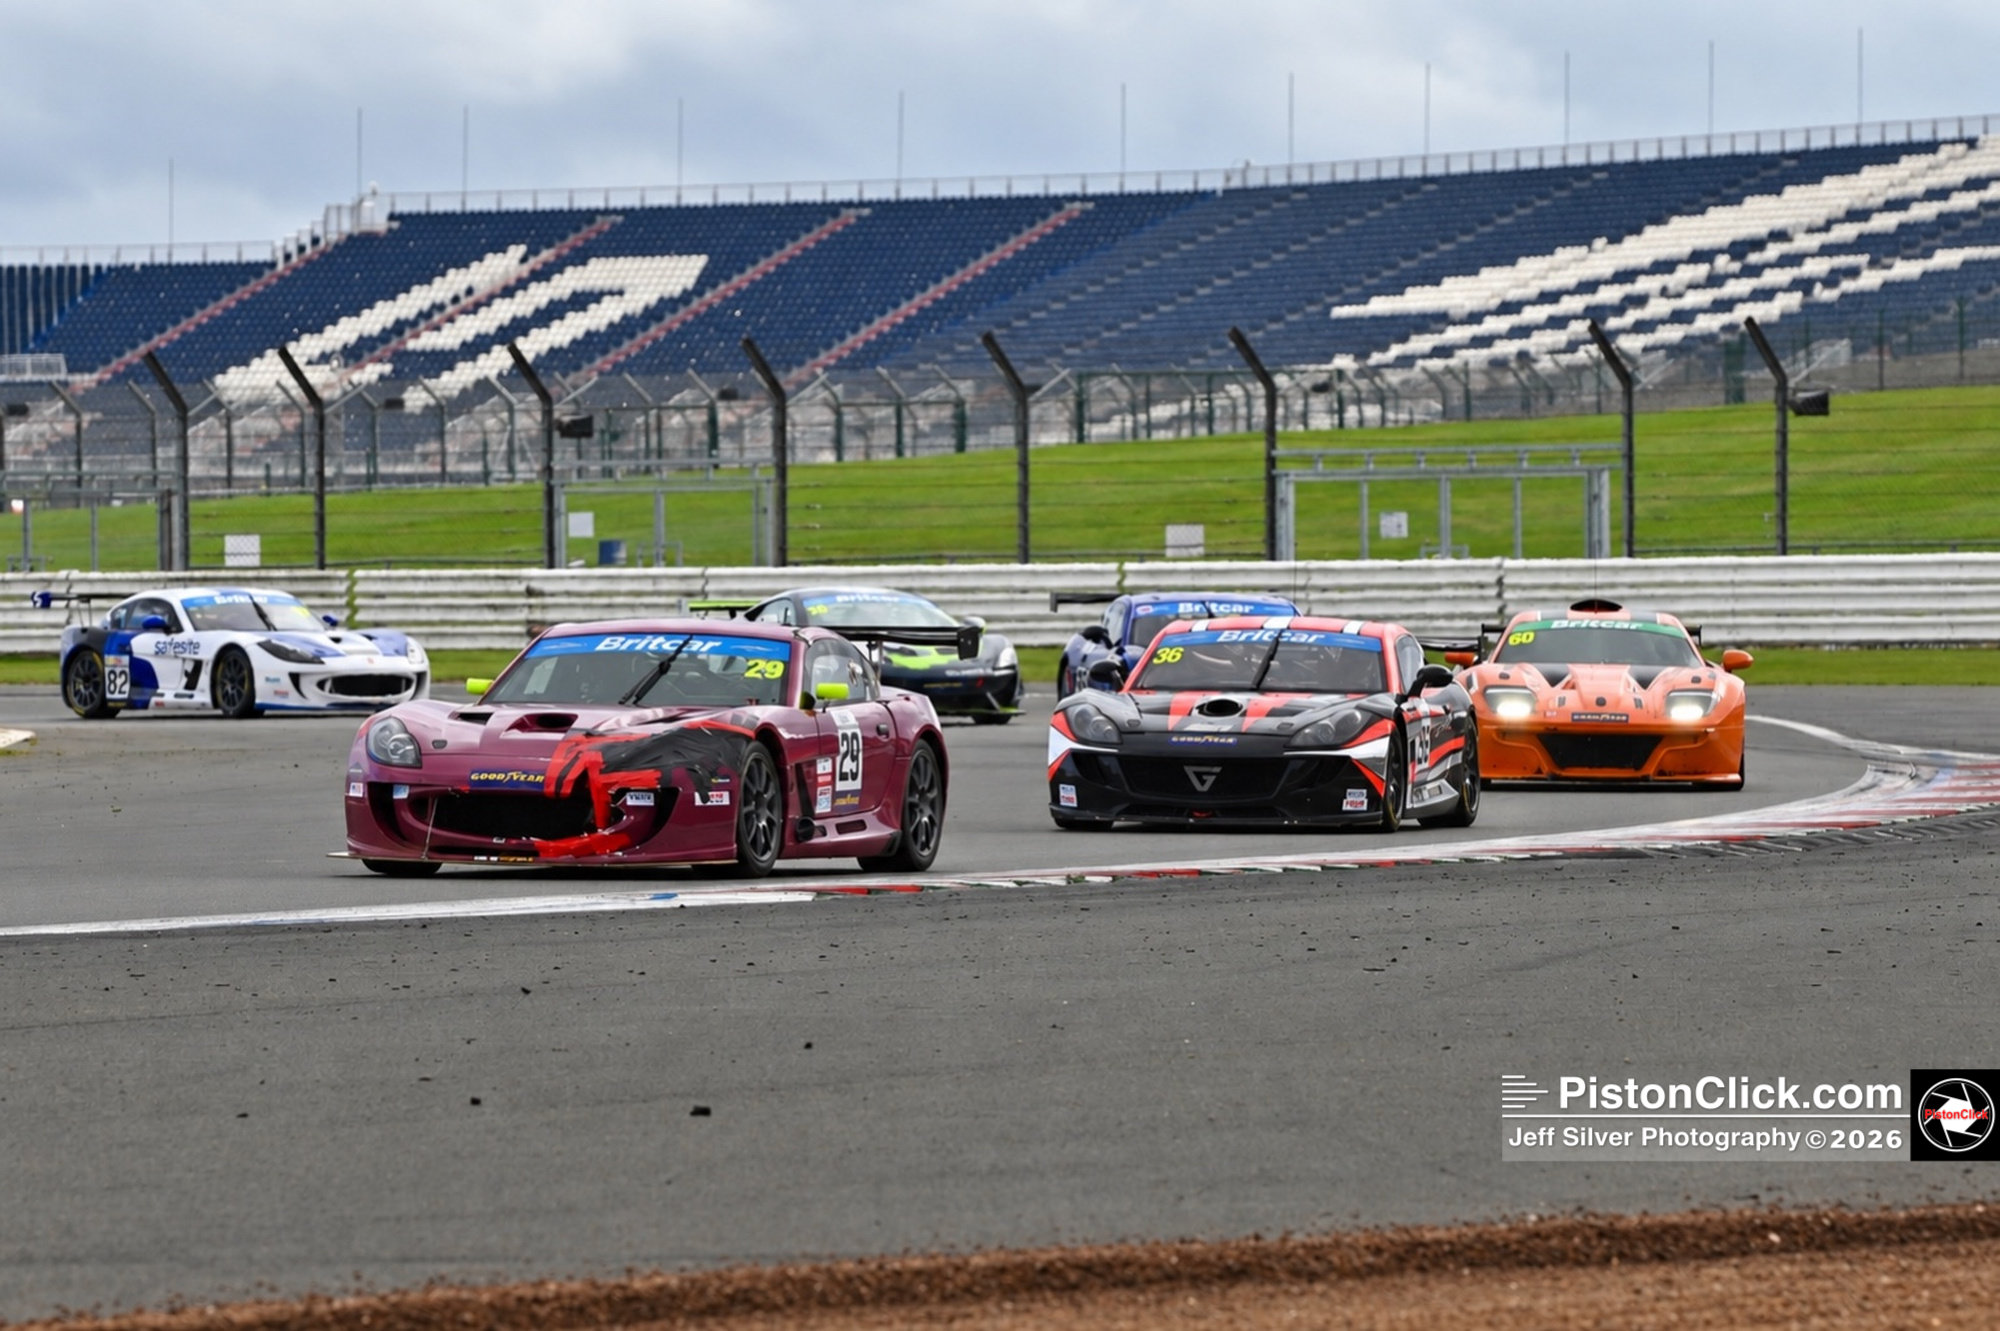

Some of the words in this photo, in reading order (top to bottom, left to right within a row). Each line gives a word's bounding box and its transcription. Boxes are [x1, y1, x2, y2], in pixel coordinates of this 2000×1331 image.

[1550, 619, 1643, 629] Britcar
[594, 635, 723, 652] Britcar
[1508, 631, 1534, 646] 60
[1152, 647, 1184, 664] 36
[744, 659, 785, 679] 29
[107, 669, 129, 696] 82
[839, 732, 861, 782] 29
[470, 771, 545, 783] GOODYEAR
